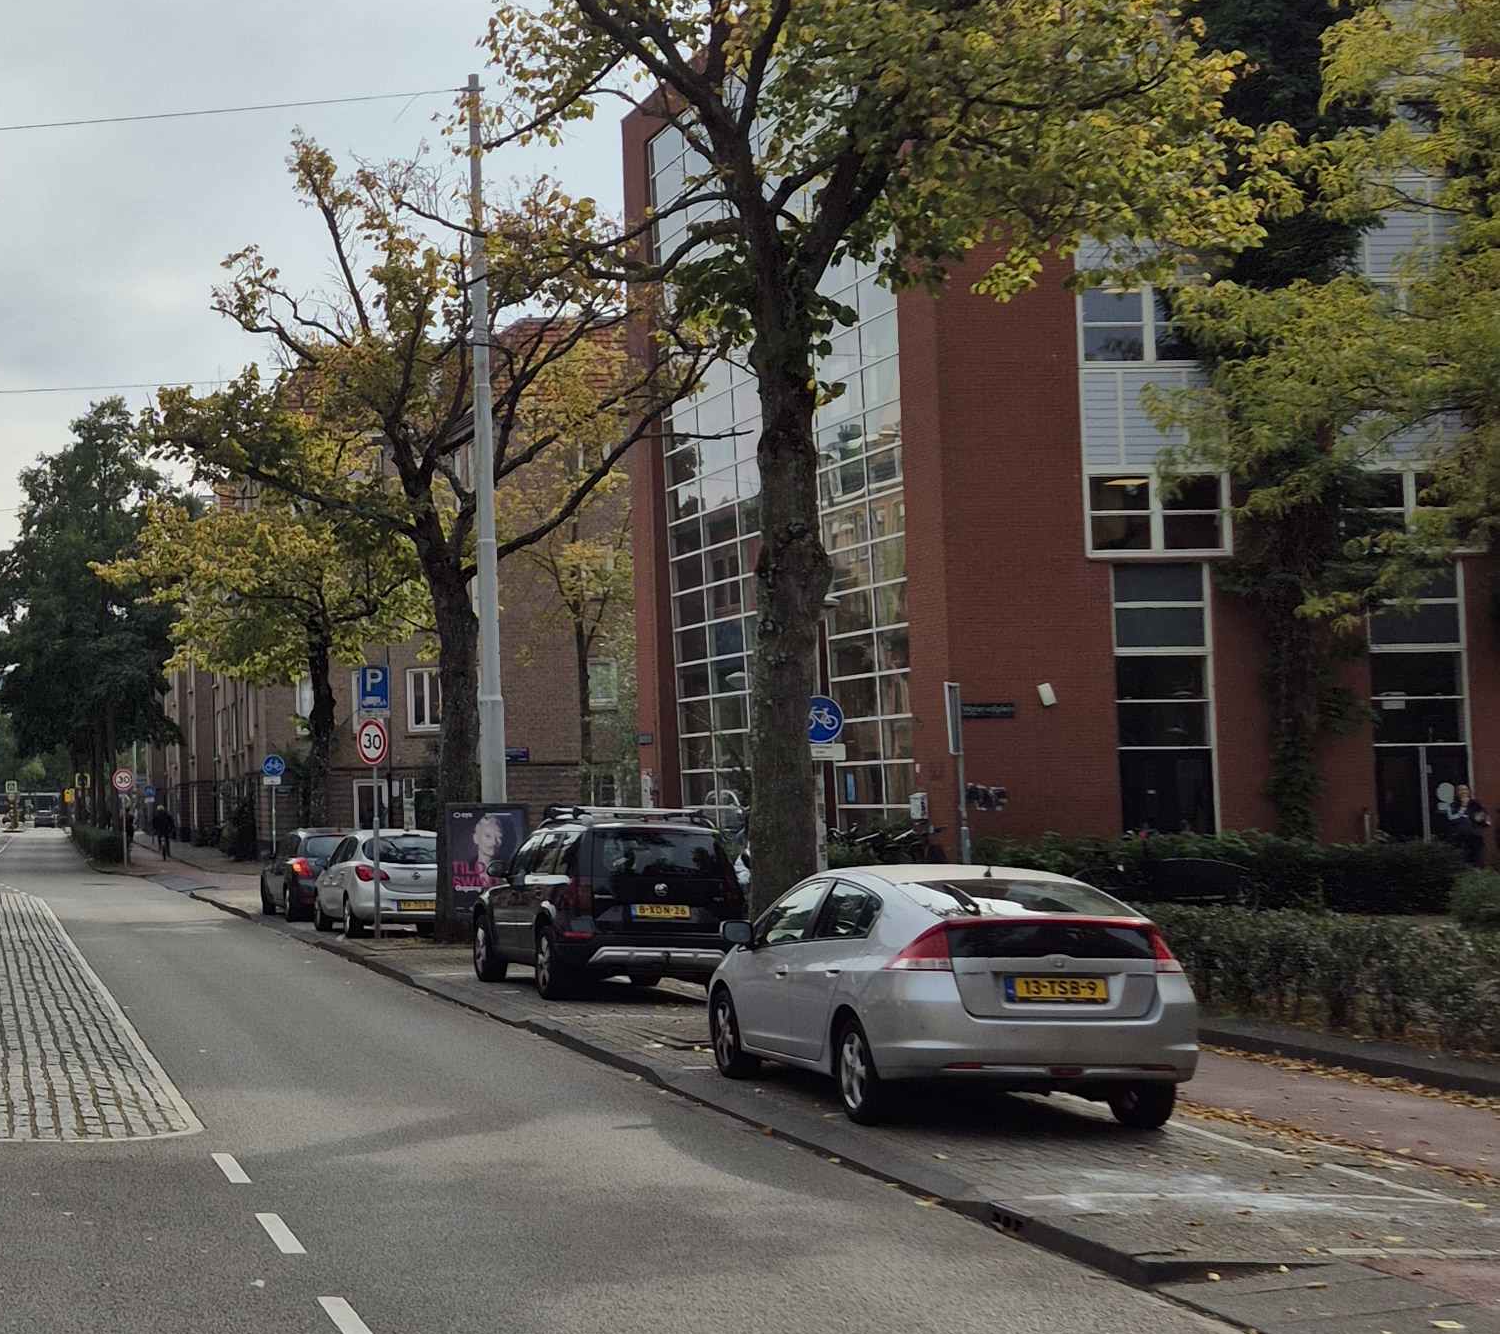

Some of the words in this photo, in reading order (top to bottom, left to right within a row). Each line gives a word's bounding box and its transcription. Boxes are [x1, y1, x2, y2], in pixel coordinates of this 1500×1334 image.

[366, 668, 383, 692] P
[363, 733, 382, 750] 30
[1024, 980, 1097, 995] 13-TSB-9
